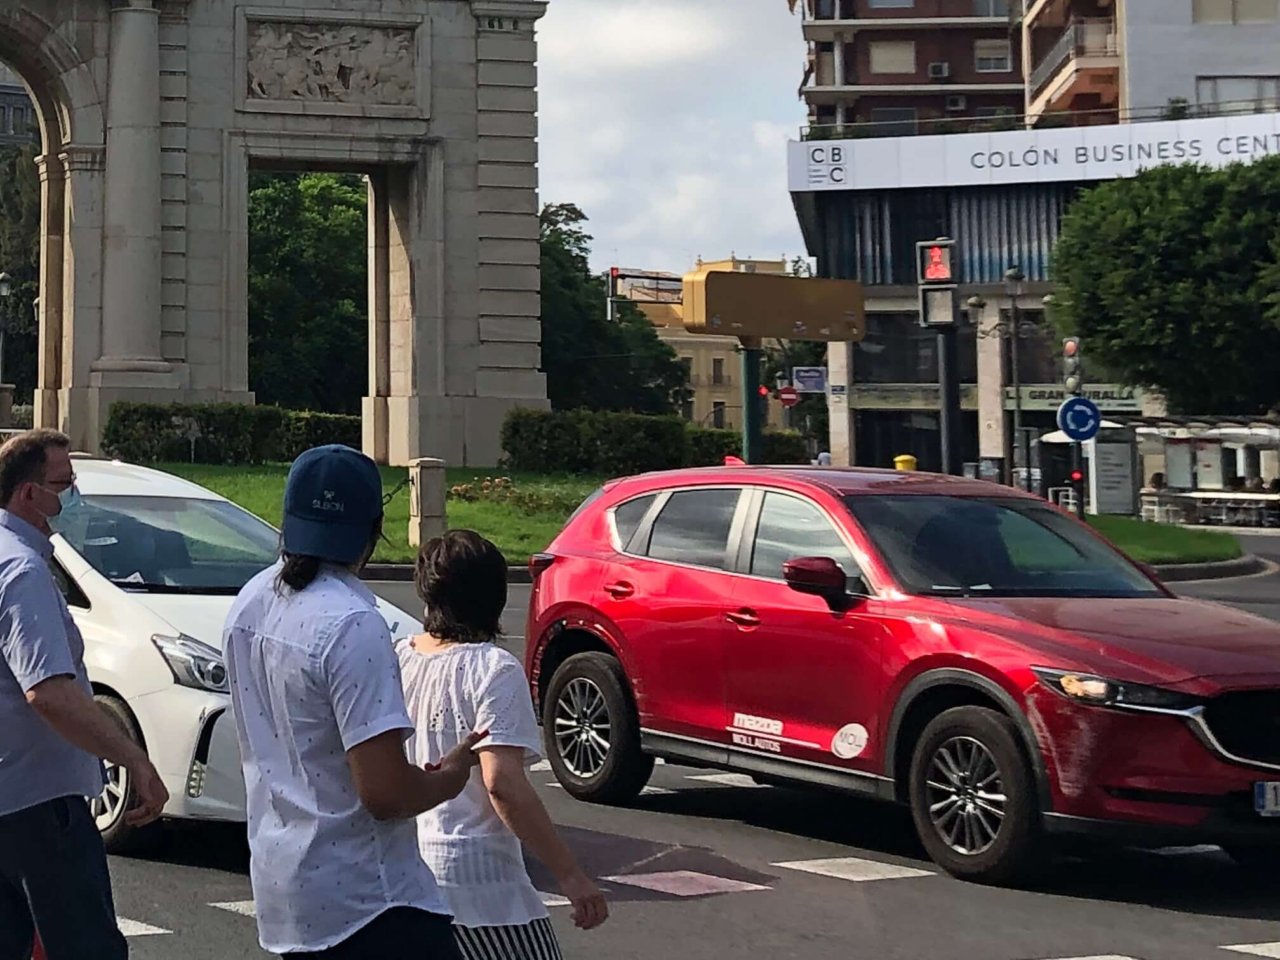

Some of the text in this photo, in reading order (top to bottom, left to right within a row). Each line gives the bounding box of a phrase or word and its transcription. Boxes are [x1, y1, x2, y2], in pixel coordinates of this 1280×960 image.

[970, 145, 1058, 169] COLÓN
[1075, 139, 1202, 164] BUSINESS
[1029, 390, 1065, 400] GRAN
[1082, 390, 1135, 400] URALLA
